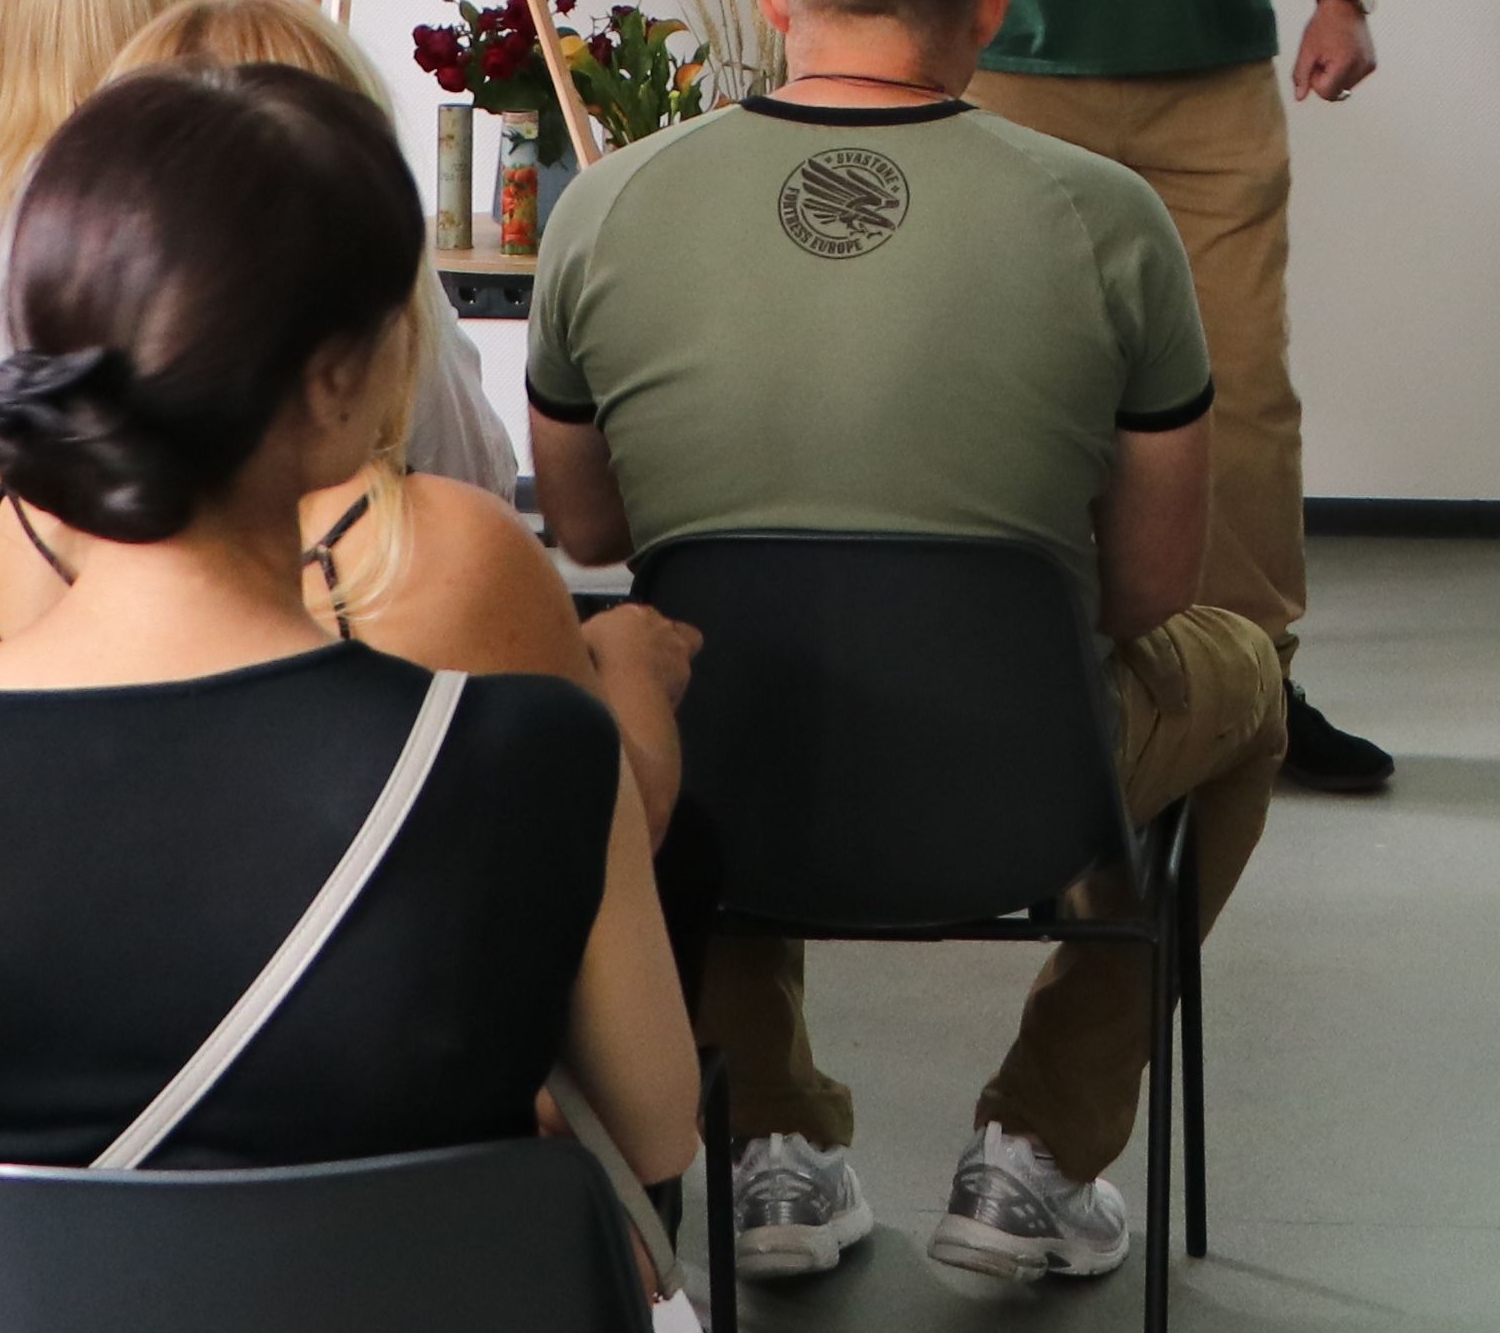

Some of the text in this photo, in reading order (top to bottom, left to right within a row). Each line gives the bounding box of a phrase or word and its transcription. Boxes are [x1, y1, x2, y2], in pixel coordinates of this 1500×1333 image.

[836, 151, 899, 186] SVASTONE
[782, 186, 864, 254] FORTRESS EUROPE
